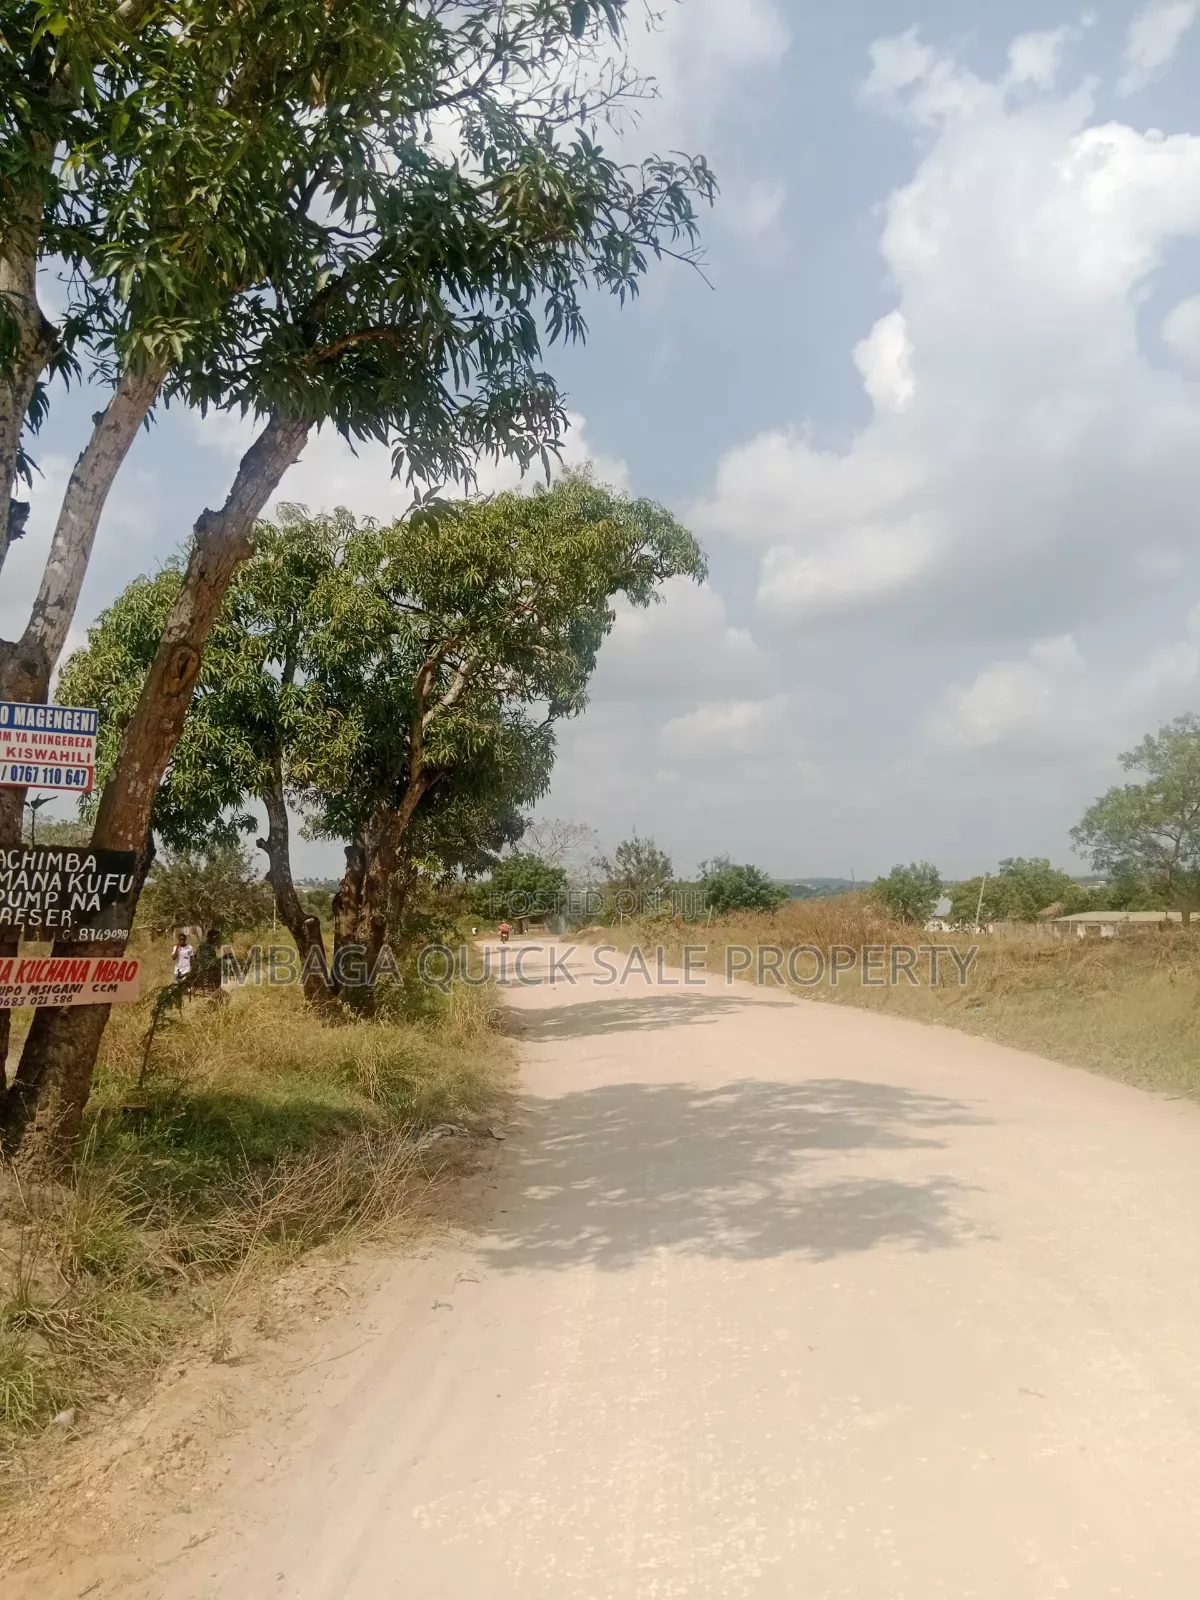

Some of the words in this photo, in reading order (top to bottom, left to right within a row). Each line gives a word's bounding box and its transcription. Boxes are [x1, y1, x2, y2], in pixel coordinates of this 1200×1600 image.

[14, 707, 96, 732] MAGENGENI
[16, 733, 28, 743] YA
[32, 734, 93, 749] KIINGEREZA
[6, 747, 91, 763] KISWAHILI
[11, 765, 39, 782] 0767
[43, 768, 61, 785] 110
[65, 769, 87, 786] 647
[70, 893, 101, 911] NA
[14, 960, 92, 984] KUCHANA
[91, 960, 138, 983] MBAO
[27, 984, 84, 996] MSIGANI
[92, 984, 118, 993] CCM
[0, 996, 27, 1007] 0683
[30, 996, 48, 1006] 021
[52, 994, 74, 1004] 586
